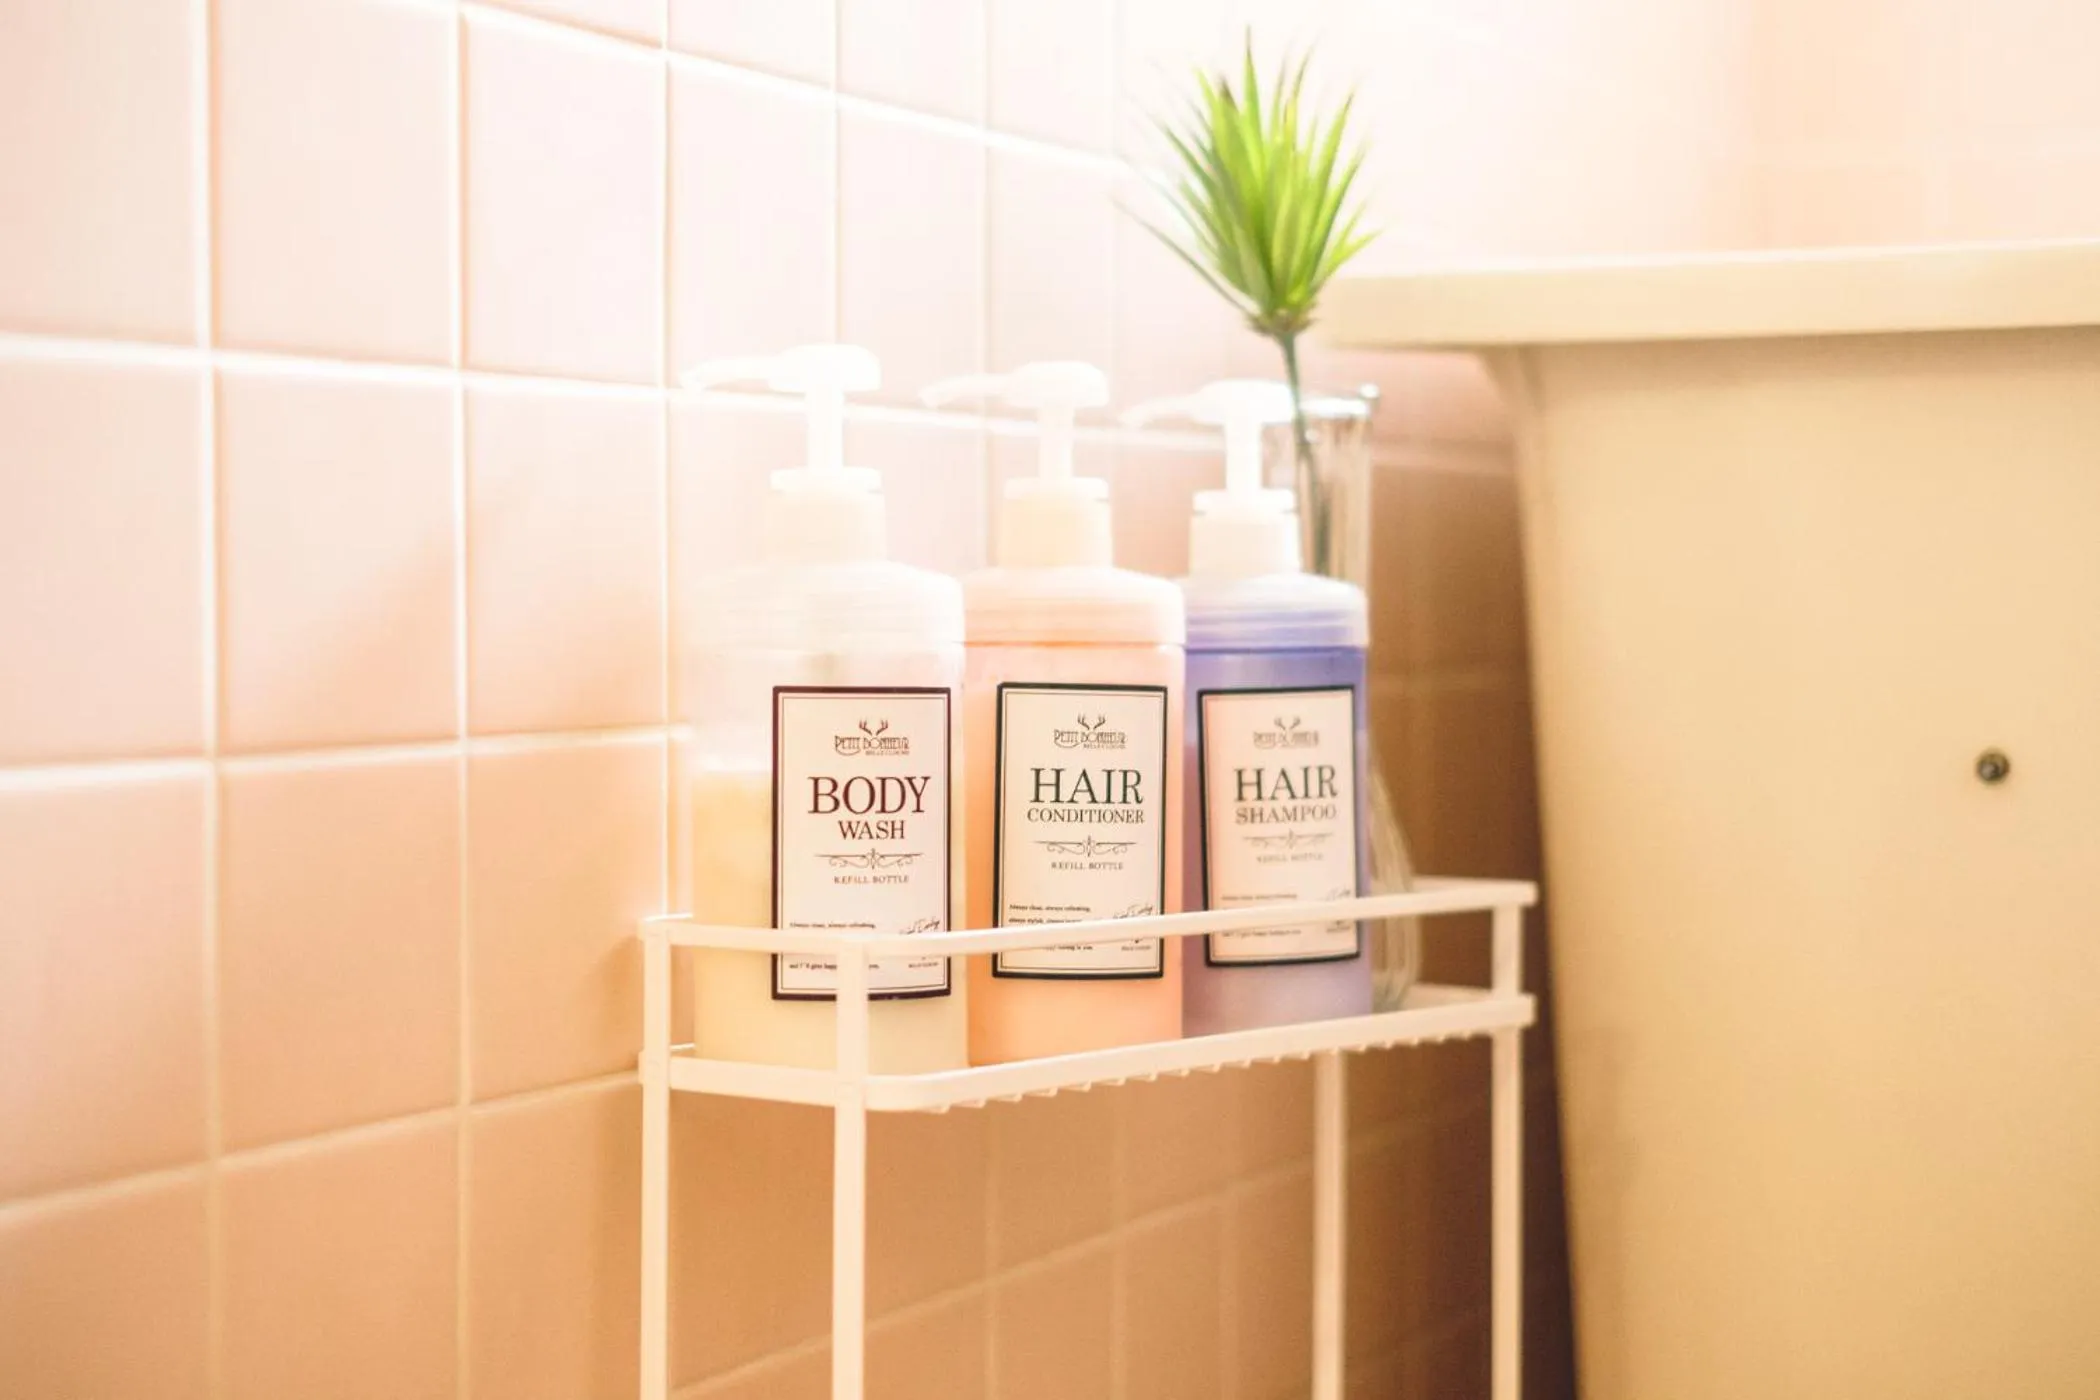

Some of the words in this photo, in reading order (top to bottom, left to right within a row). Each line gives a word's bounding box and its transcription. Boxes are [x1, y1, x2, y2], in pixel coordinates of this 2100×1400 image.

[1030, 768, 1144, 805] HAIR
[1233, 765, 1338, 802] HAIR
[807, 776, 931, 815] BODY
[1027, 808, 1145, 824] CONDITIONER
[1235, 804, 1338, 825] SHAMPOO
[838, 820, 906, 840] WASH
[1051, 862, 1085, 870] REFILL
[1088, 862, 1124, 870] BOTTLE
[834, 875, 869, 884] REFILL
[872, 875, 910, 884] BOTTLE
